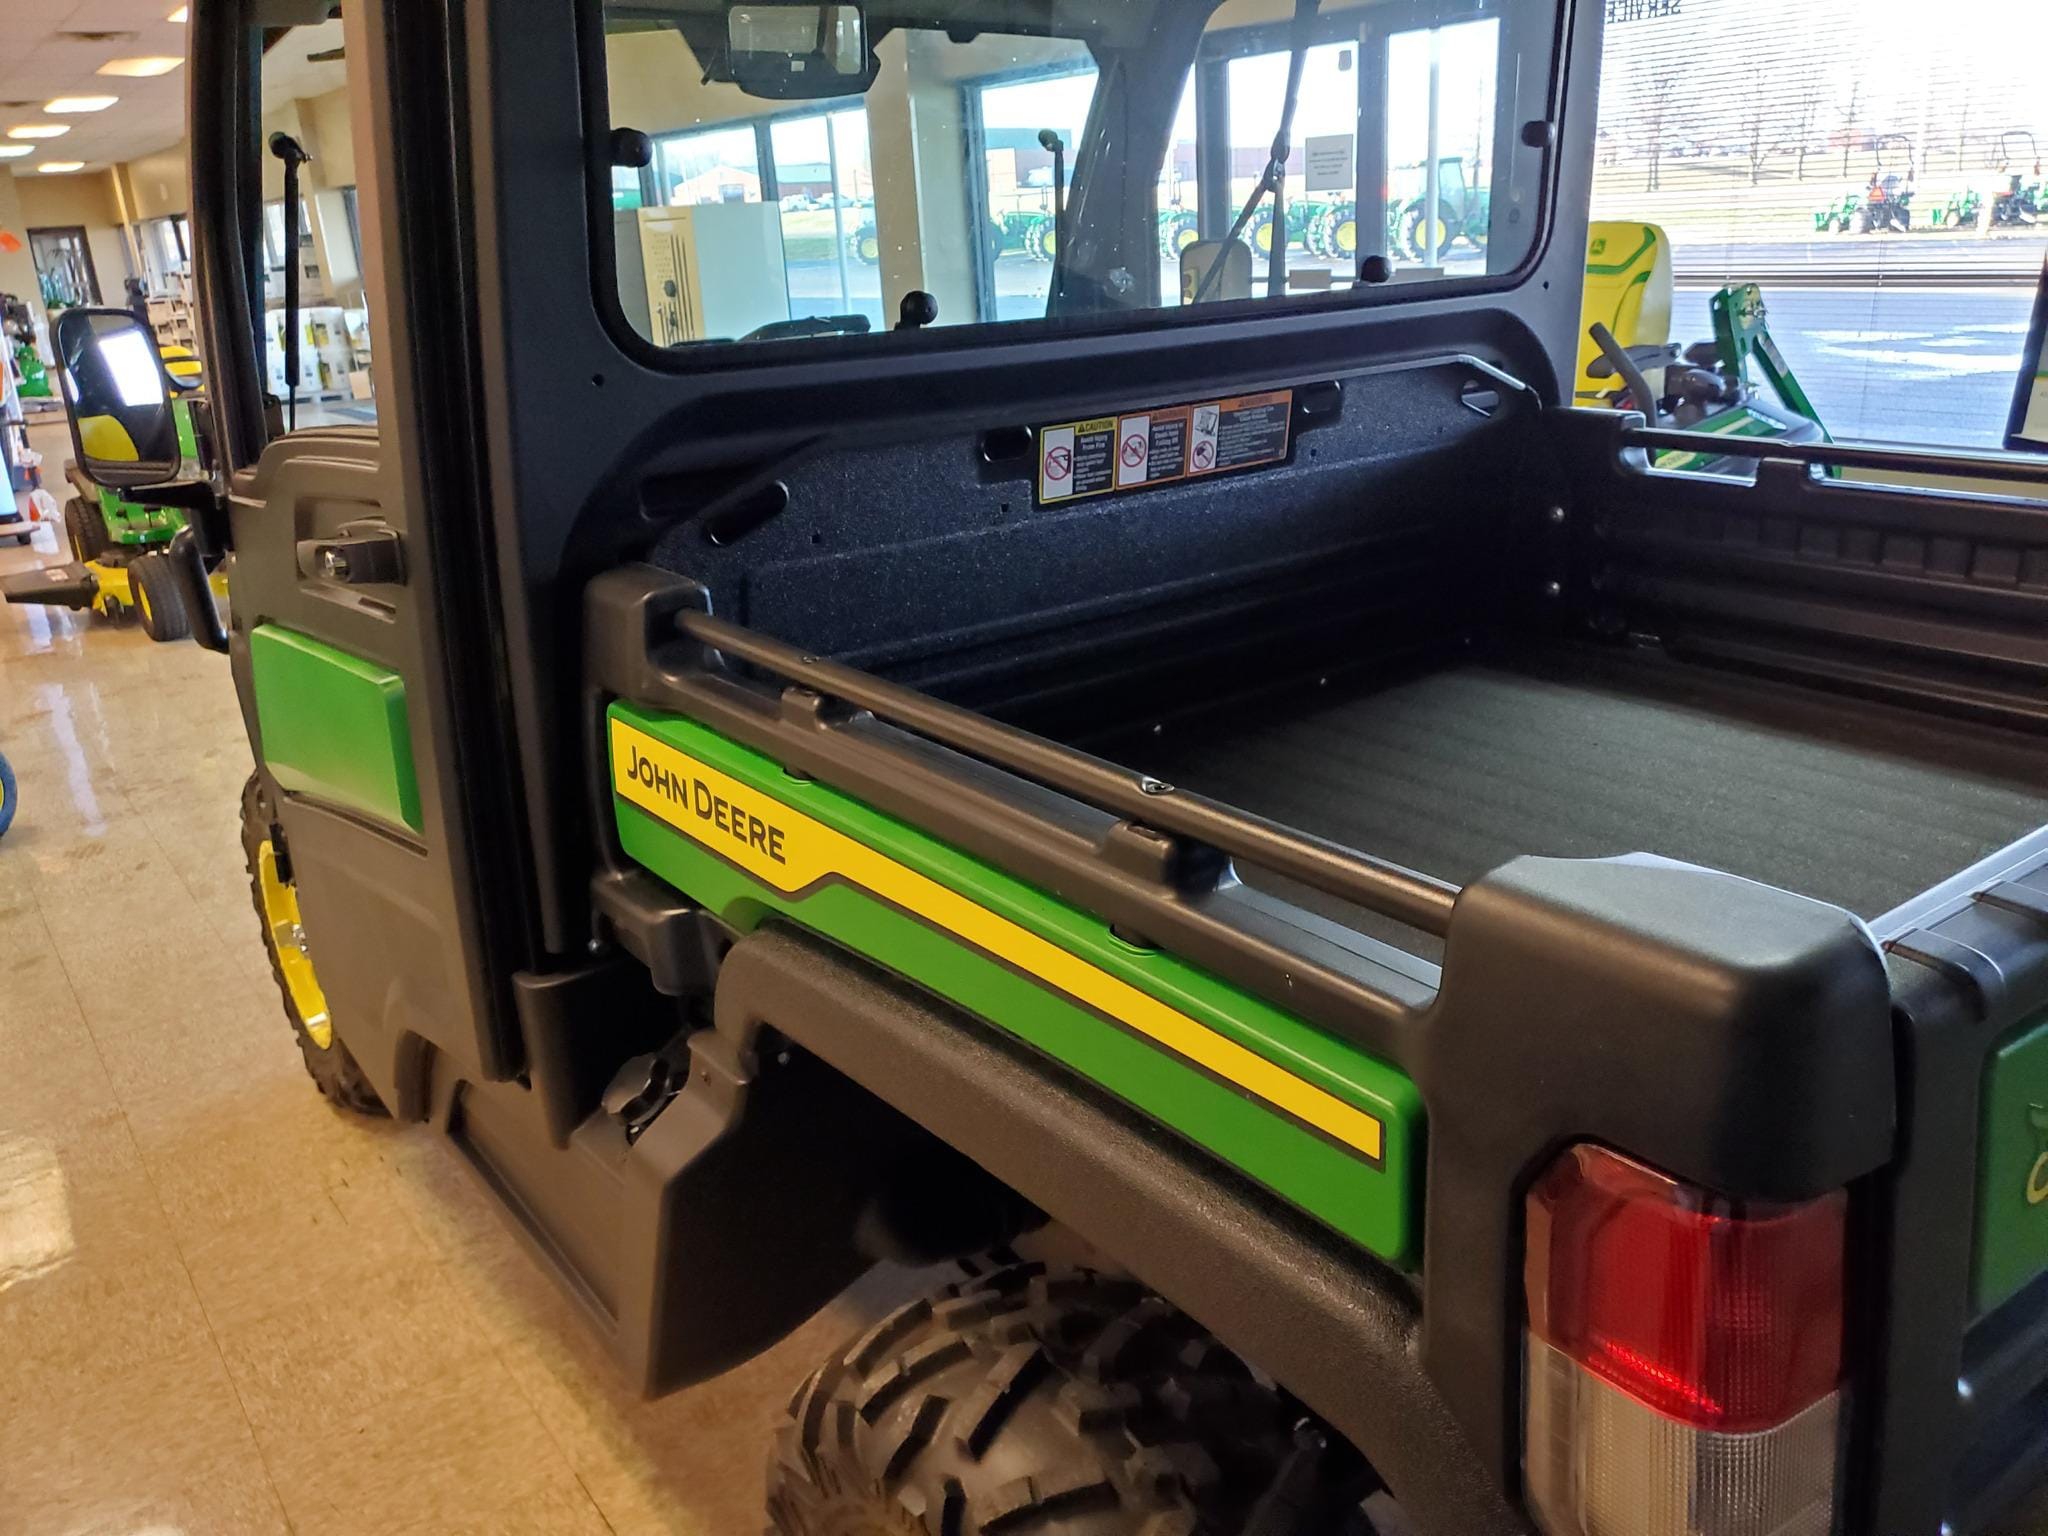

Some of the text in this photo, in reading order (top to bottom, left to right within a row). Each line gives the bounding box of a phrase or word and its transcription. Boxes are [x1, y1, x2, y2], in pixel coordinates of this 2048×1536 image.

[1085, 420, 1113, 432] CAUTION
[627, 745, 786, 866] JOHN DEERE
